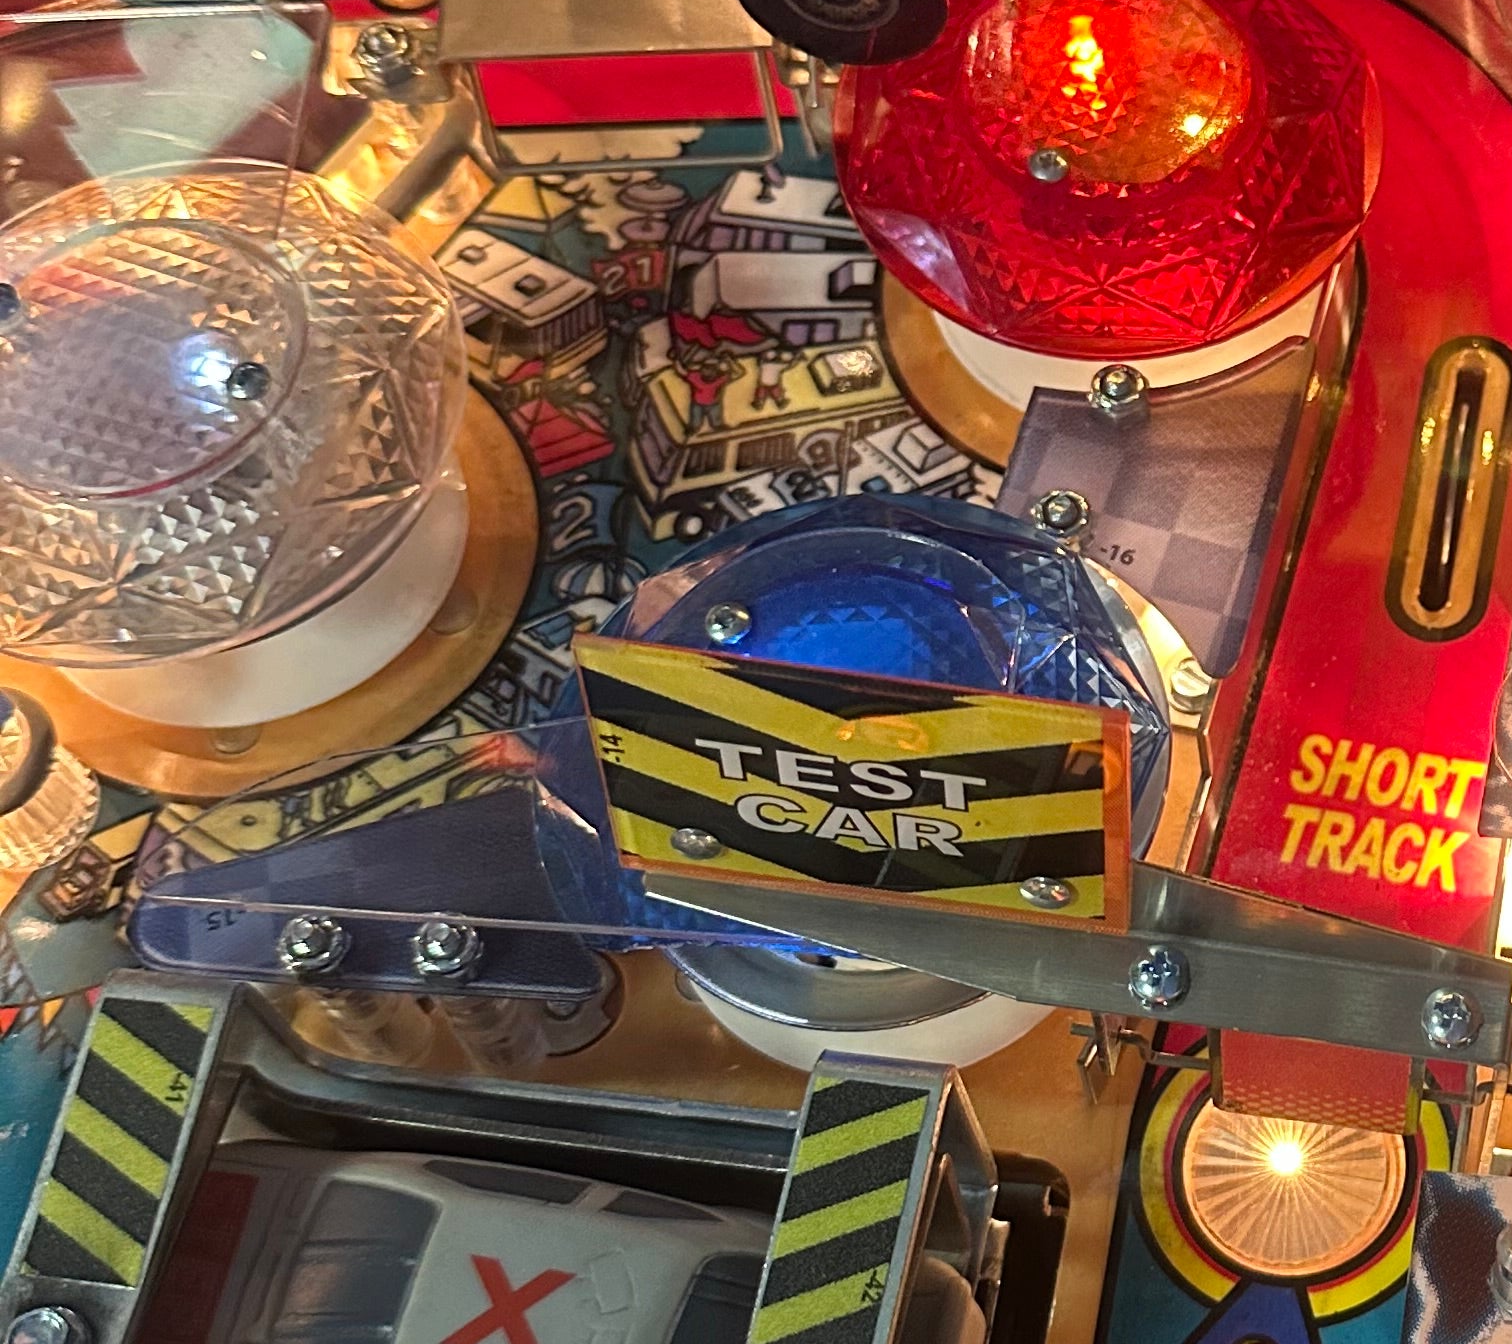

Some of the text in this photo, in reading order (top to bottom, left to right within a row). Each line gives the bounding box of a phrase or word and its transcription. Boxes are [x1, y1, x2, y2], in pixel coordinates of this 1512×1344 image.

[552, 493, 597, 552] 2
[1100, 544, 1136, 566] -16
[693, 738, 988, 814] TEST
[1289, 733, 1487, 820] SHORT
[735, 793, 967, 859] CAR
[1279, 805, 1475, 893] TRACK
